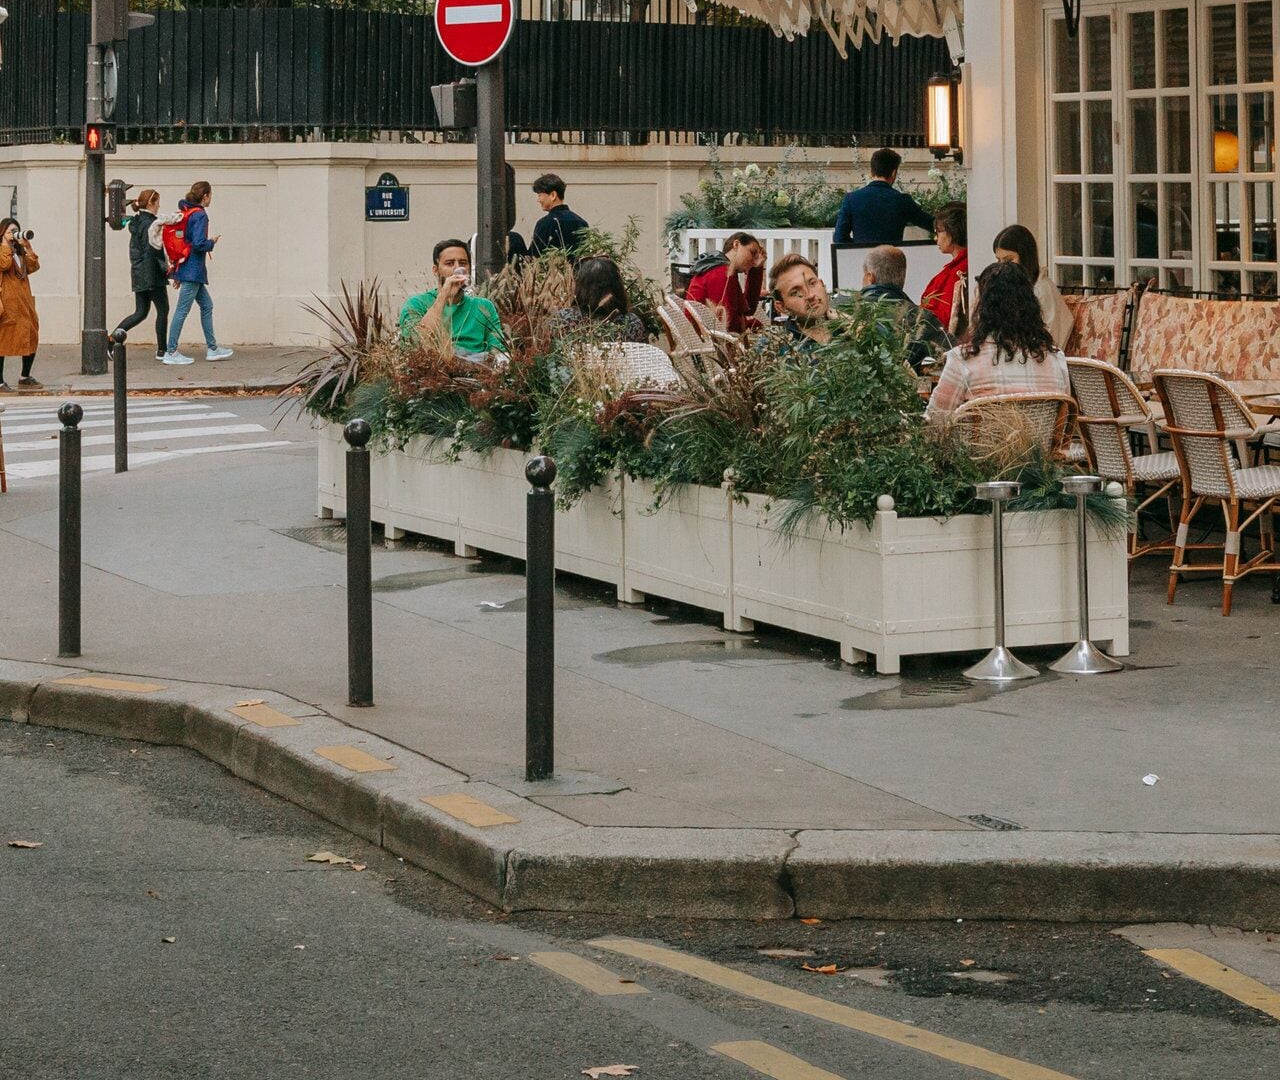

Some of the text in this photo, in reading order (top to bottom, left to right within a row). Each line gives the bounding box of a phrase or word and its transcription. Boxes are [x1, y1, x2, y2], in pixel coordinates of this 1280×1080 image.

[381, 192, 393, 200] RUE
[383, 200, 391, 208] DE
[369, 207, 405, 216] L'UNIVERSITÉ
